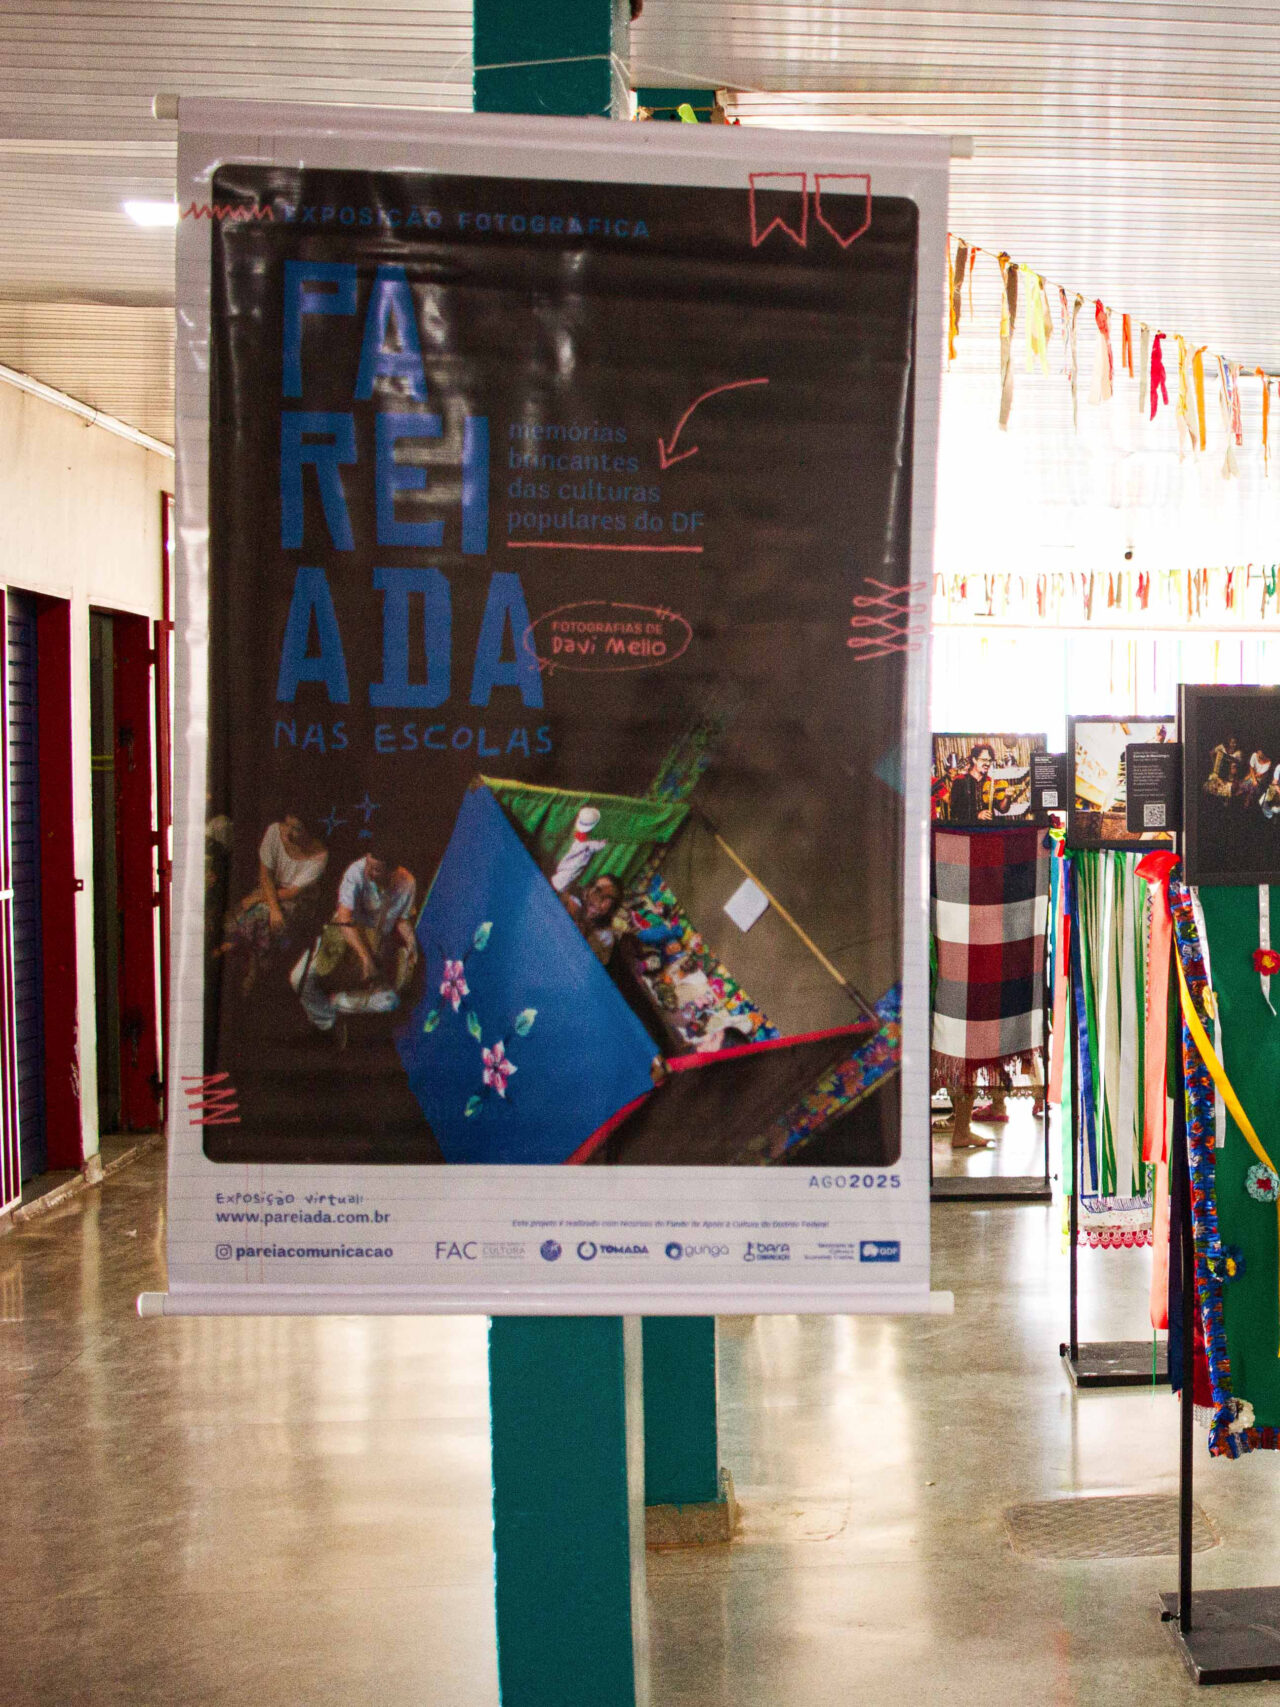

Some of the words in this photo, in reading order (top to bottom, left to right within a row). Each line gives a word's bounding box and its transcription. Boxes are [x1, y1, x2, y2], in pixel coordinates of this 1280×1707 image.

[508, 420, 628, 443] memórias
[508, 447, 639, 474] brincantes
[507, 477, 551, 500] das
[557, 478, 662, 503] culturas
[507, 508, 627, 536] populares
[634, 510, 664, 532] do
[672, 511, 705, 533] DF
[552, 621, 643, 635] FOTOGRAFIAS
[645, 622, 663, 635] DE
[551, 634, 596, 656] Davi
[604, 636, 668, 657] Mello
[273, 719, 349, 754] NAS
[373, 722, 553, 758] ESCOLAS
[808, 1174, 901, 1189] AGO2025
[215, 1209, 391, 1227] www.pareiada.com.br
[235, 1243, 394, 1261] pareiacomunicacao
[435, 1240, 478, 1261] FAC
